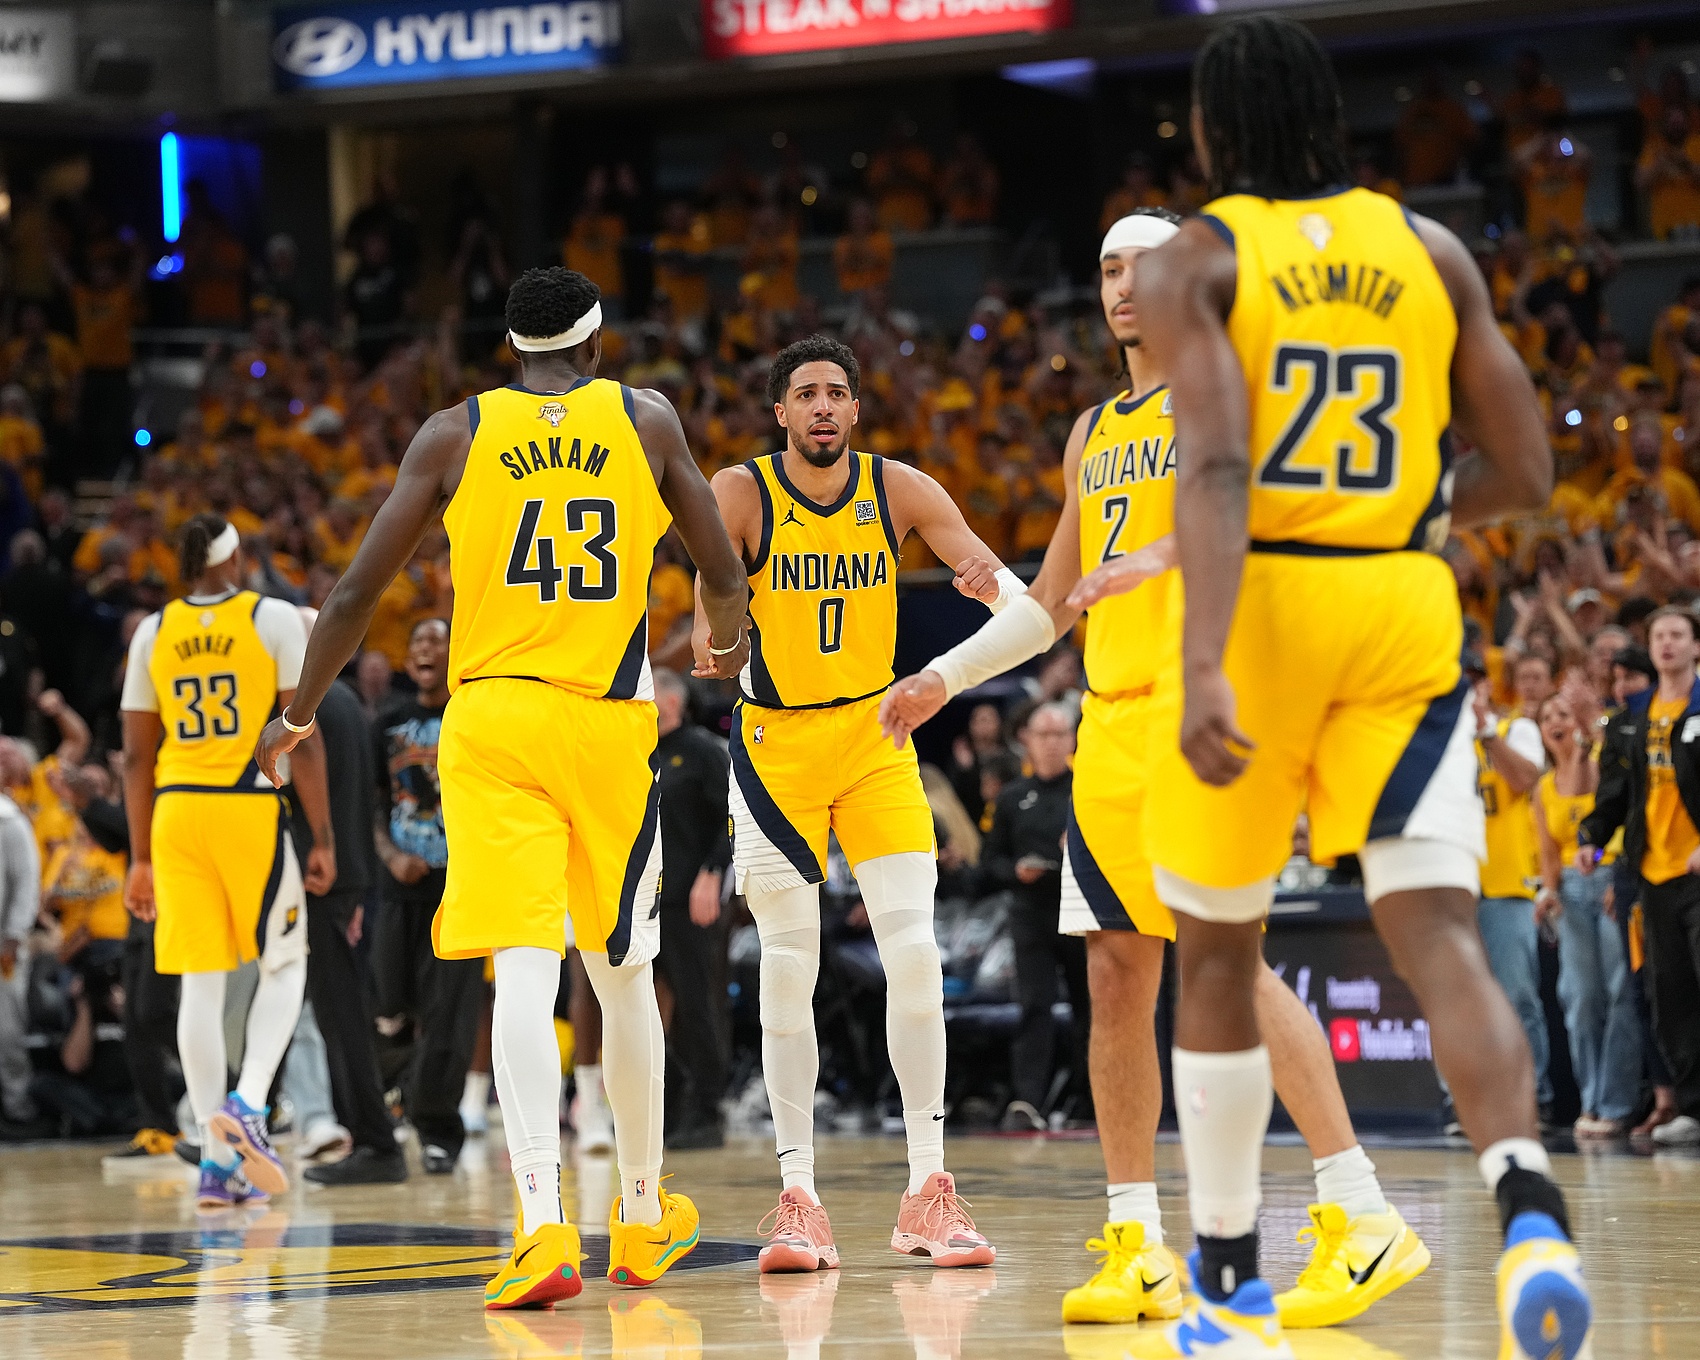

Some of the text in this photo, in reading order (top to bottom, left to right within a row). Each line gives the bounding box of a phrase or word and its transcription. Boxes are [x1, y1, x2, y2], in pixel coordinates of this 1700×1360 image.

[373, 2, 622, 67] HYUNDAI
[1269, 262, 1406, 319] NESMITH
[1252, 342, 1402, 495] 23
[499, 436, 611, 481] SIAKAM
[1079, 435, 1177, 500] NDIANA
[504, 498, 618, 603] 43
[1101, 494, 1130, 566] 2
[771, 550, 888, 592] INDIANA
[173, 633, 235, 662] TURNER
[818, 597, 845, 655] 0
[173, 673, 240, 742] 33
